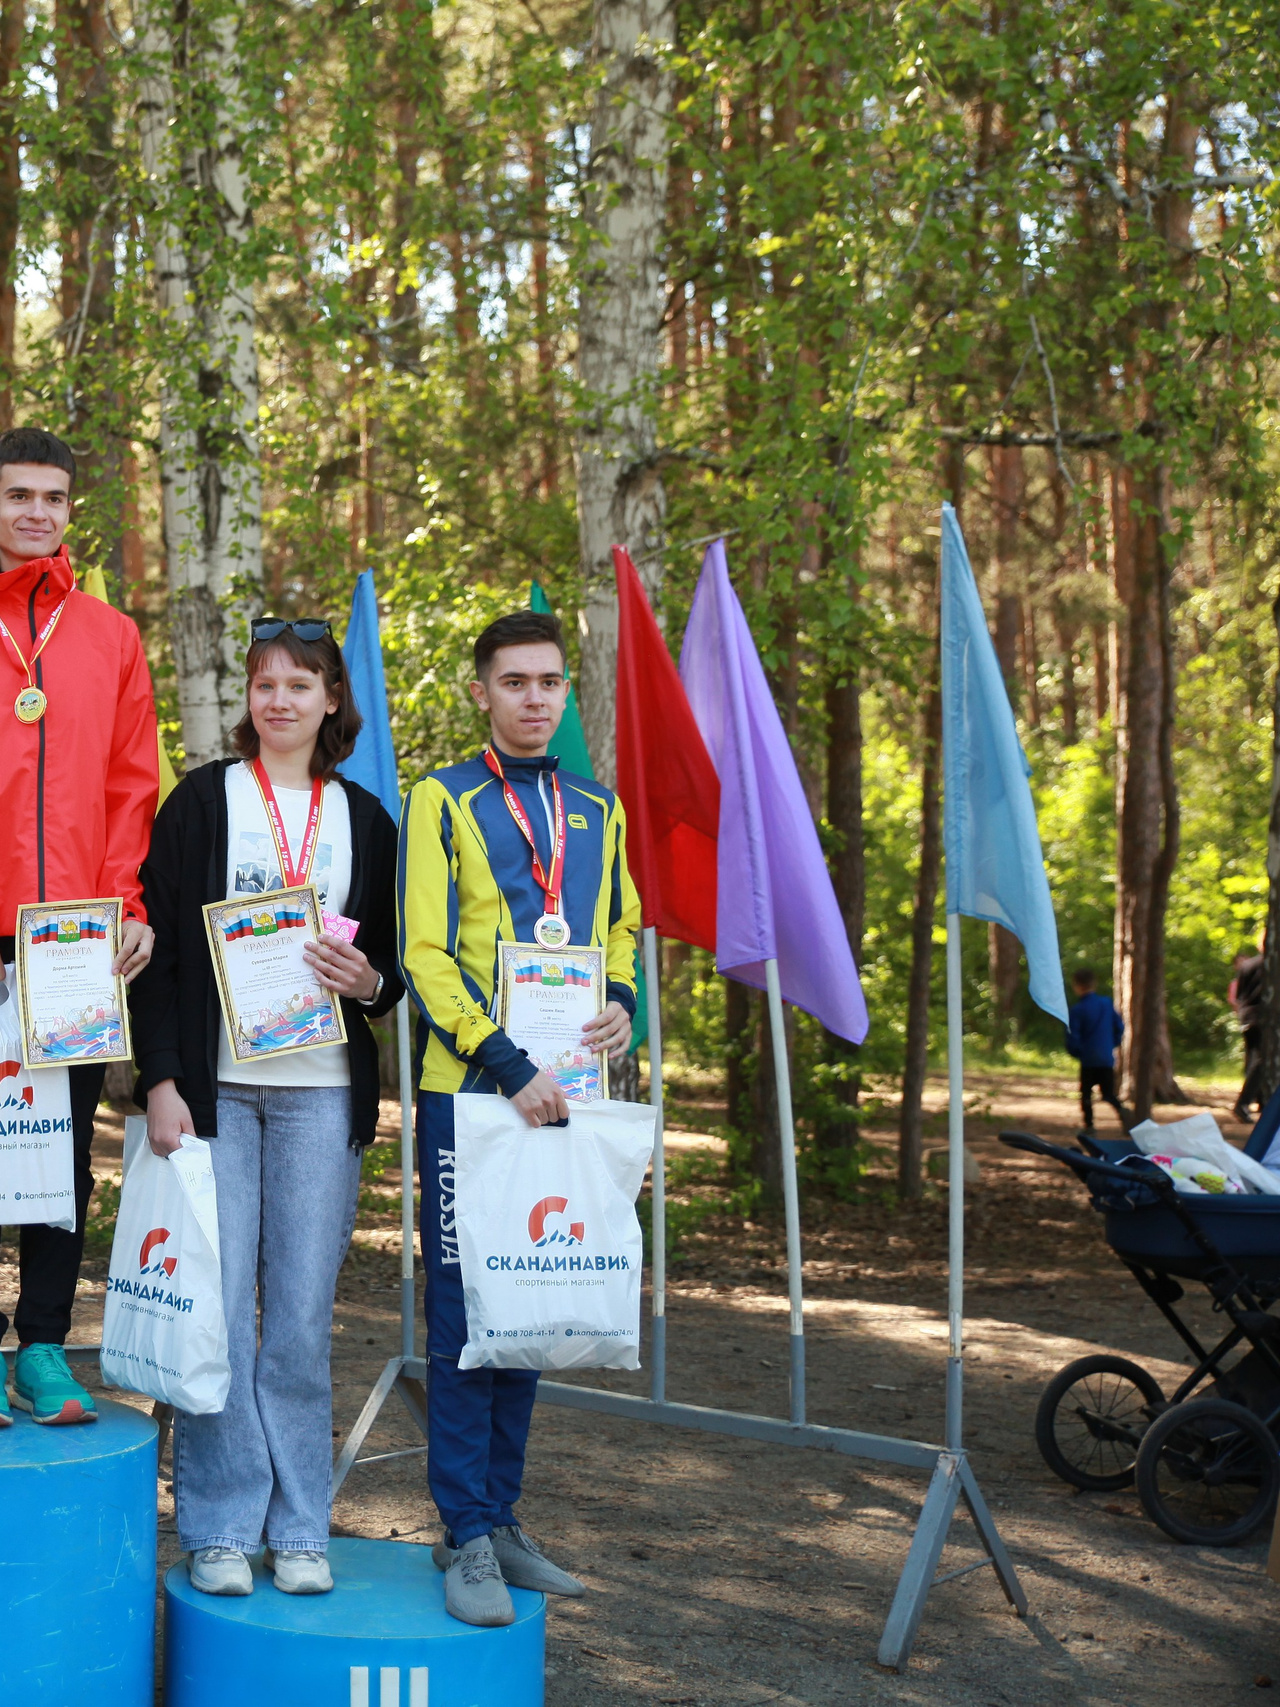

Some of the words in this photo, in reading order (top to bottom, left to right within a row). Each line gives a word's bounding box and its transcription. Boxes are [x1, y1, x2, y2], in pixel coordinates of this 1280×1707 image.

[40, 624, 51, 640] Иван
[268, 801, 277, 816] Иван
[507, 792, 517, 809] Иван
[514, 810, 522, 819] да
[272, 816, 279, 826] да
[275, 826, 284, 848] Марья
[306, 826, 315, 848] Марья
[306, 848, 311, 857] да
[300, 859, 308, 874] Иван
[242, 935, 293, 952] ГРАМОТА
[46, 946, 92, 957] ГРАМОТА
[251, 957, 272, 965] Суворова
[529, 990, 576, 999] ГРАМОТА
[438, 1147, 460, 1265] RUSSIA
[486, 1255, 630, 1272] СКАНДИНАВИЯ
[516, 1278, 567, 1287] спортивный
